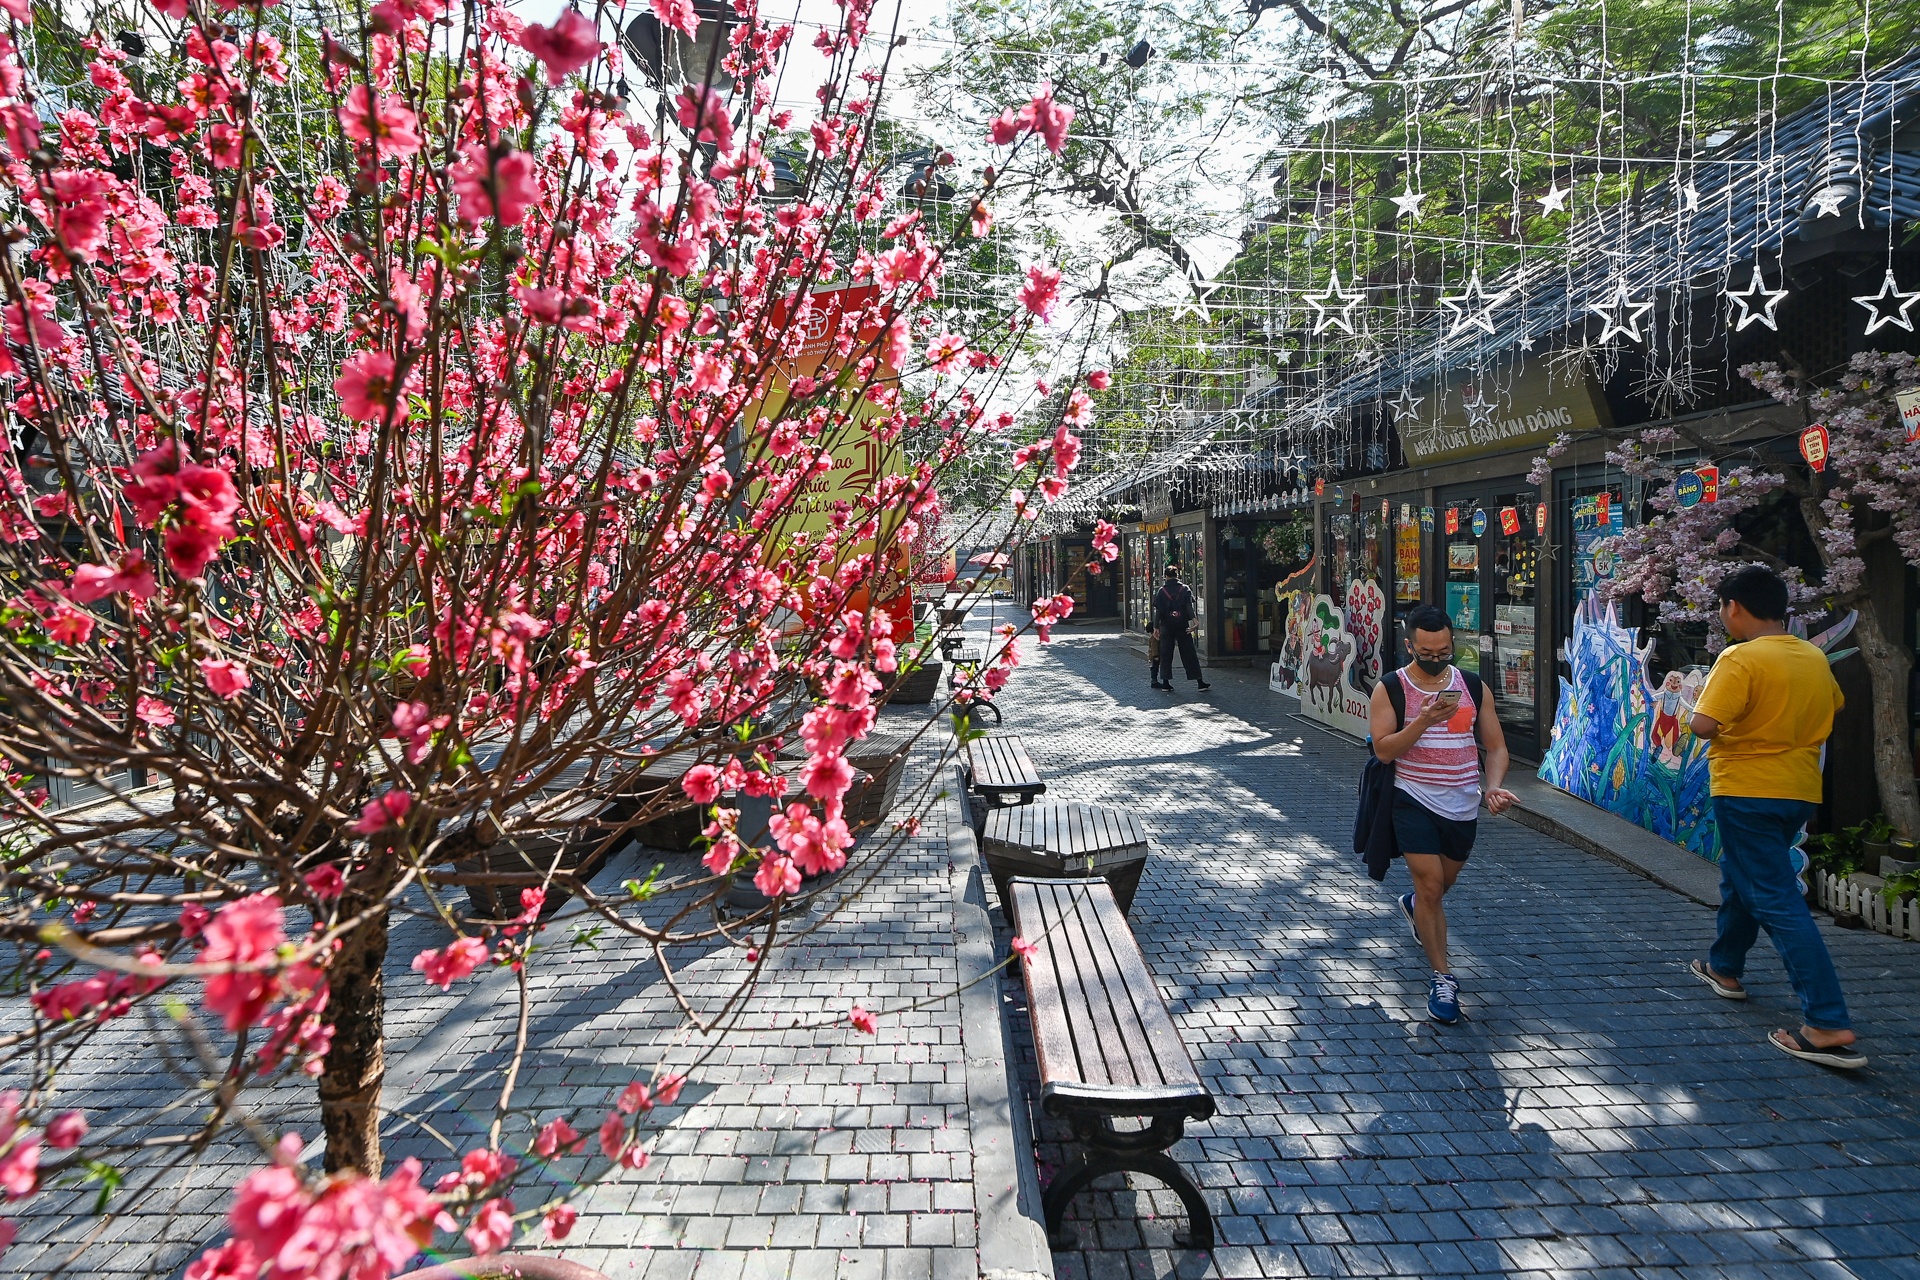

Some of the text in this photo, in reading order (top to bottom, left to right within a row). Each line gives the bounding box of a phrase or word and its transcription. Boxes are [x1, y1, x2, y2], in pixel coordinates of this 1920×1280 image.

[816, 339, 829, 349] PHỐ
[1499, 417, 1526, 439] KIM
[1526, 405, 1573, 432] ĐỒNG
[1596, 503, 1606, 514] UỔI
[1599, 561, 1609, 571] 5K
[1346, 698, 1368, 720] 2021
